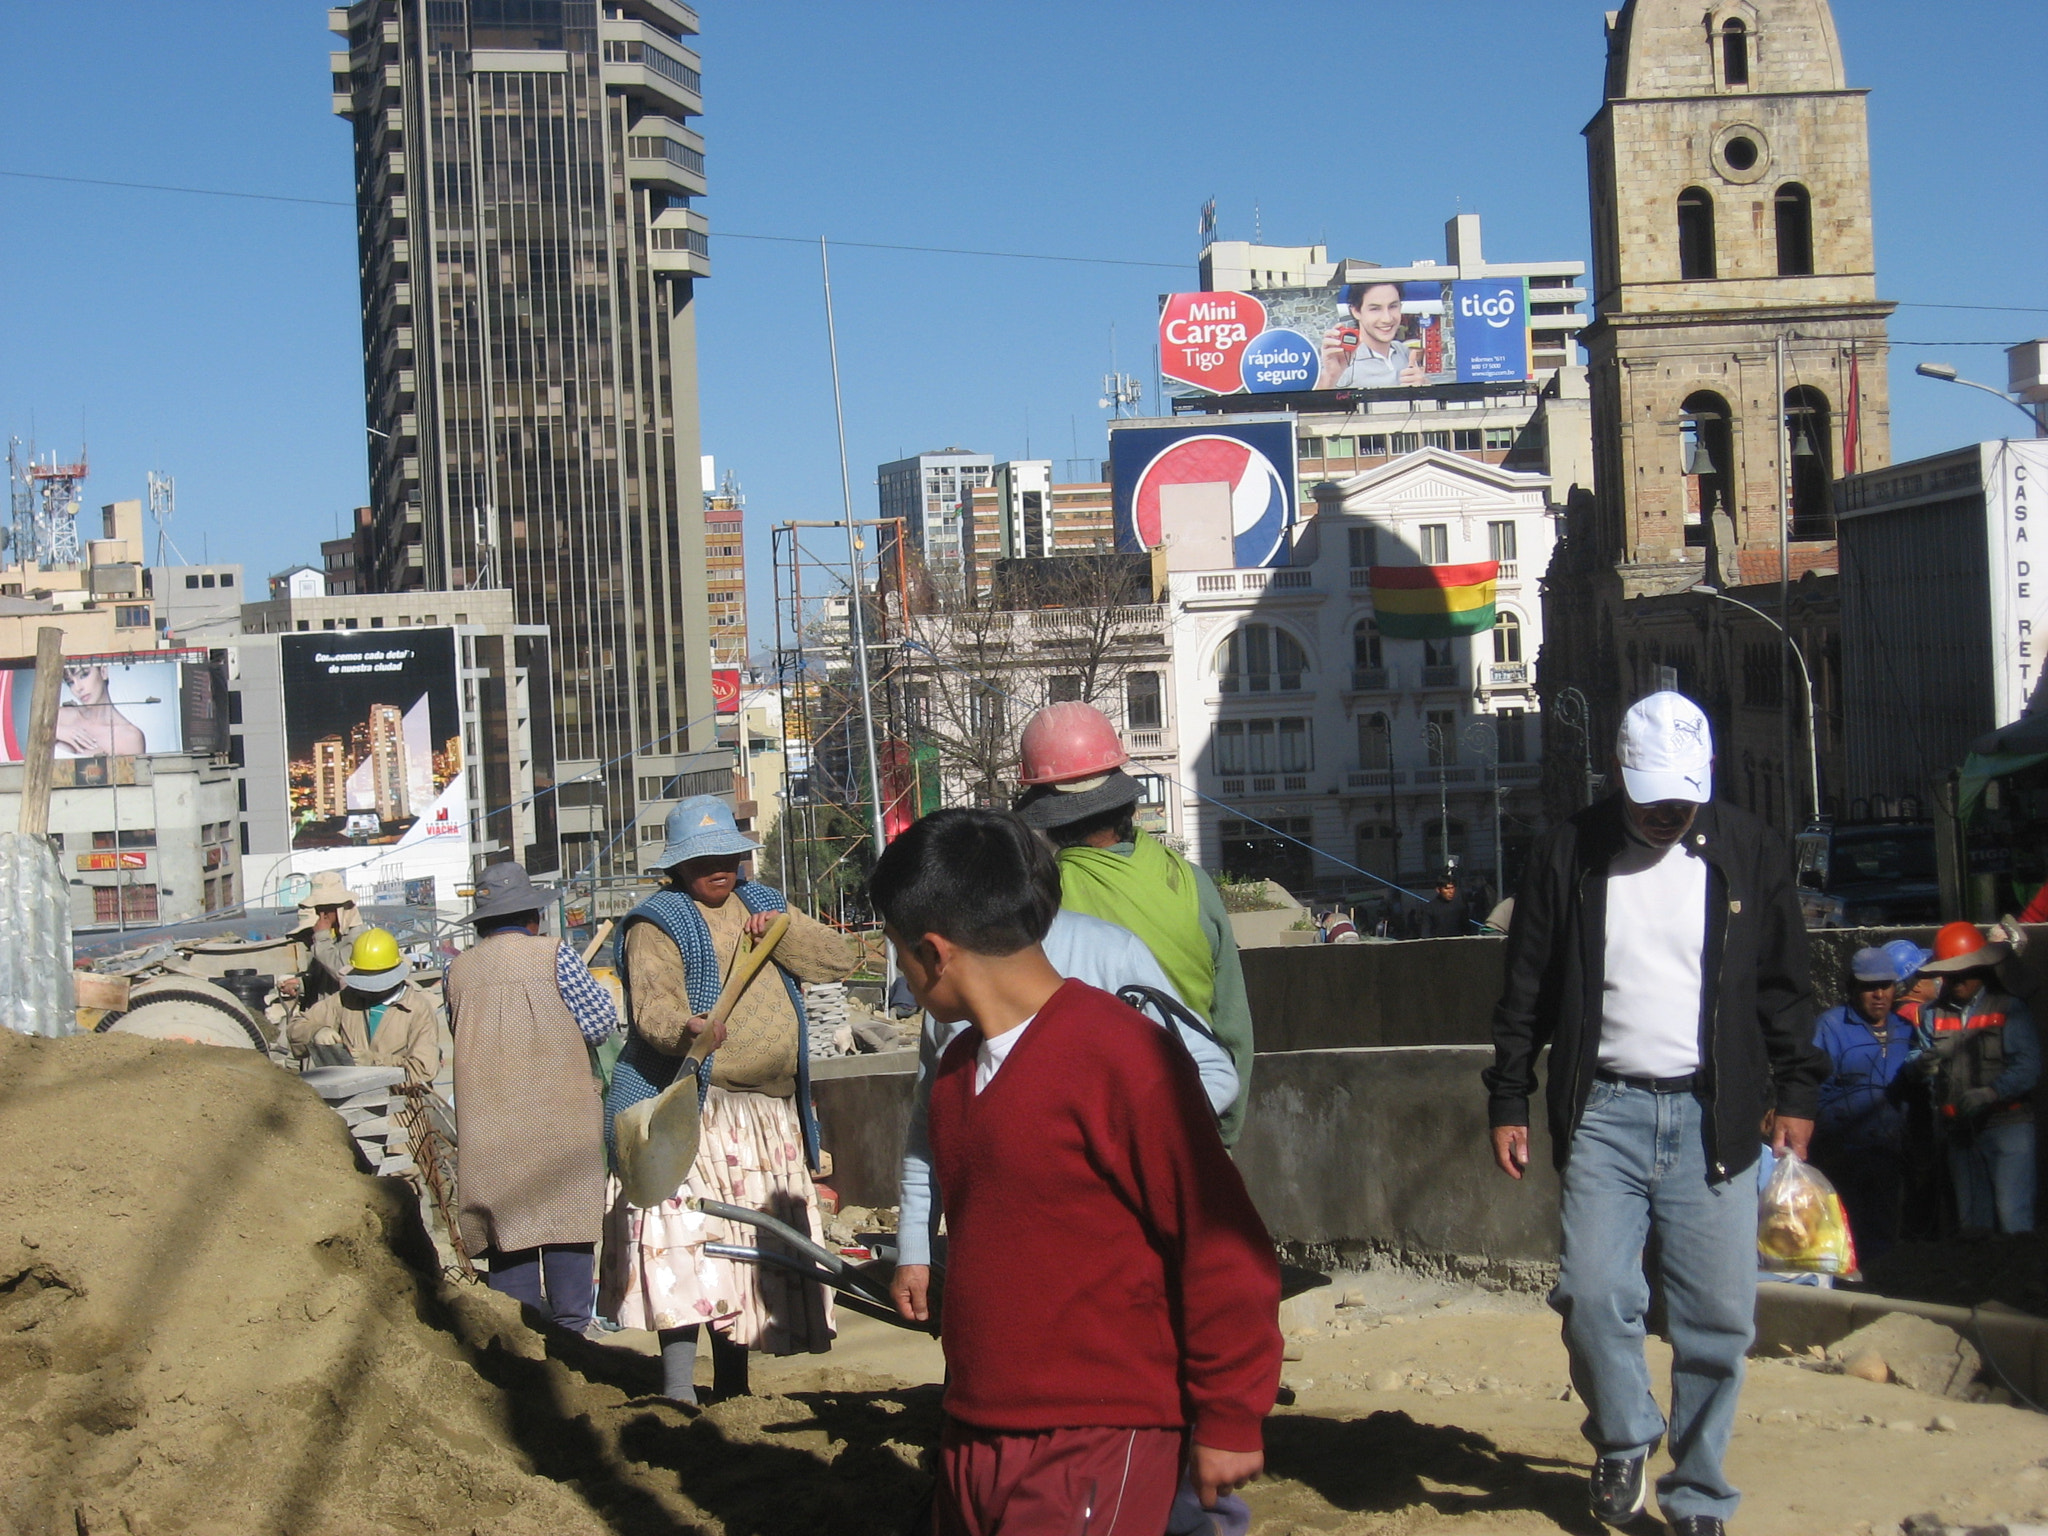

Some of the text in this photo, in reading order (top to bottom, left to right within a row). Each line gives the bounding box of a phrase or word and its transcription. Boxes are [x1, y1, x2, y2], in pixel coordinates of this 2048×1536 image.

[1189, 301, 1236, 321] Mini
[1166, 319, 1247, 350] Carga
[1182, 348, 1224, 371] Tigo
[1248, 349, 1311, 368] rápido y
[1256, 368, 1308, 385] seguro
[2014, 465, 2031, 711] CASA DE RETI
[364, 651, 385, 660] cada
[341, 664, 373, 673] nuestra
[374, 662, 403, 672] ciudad
[426, 825, 459, 835] VIACHA
